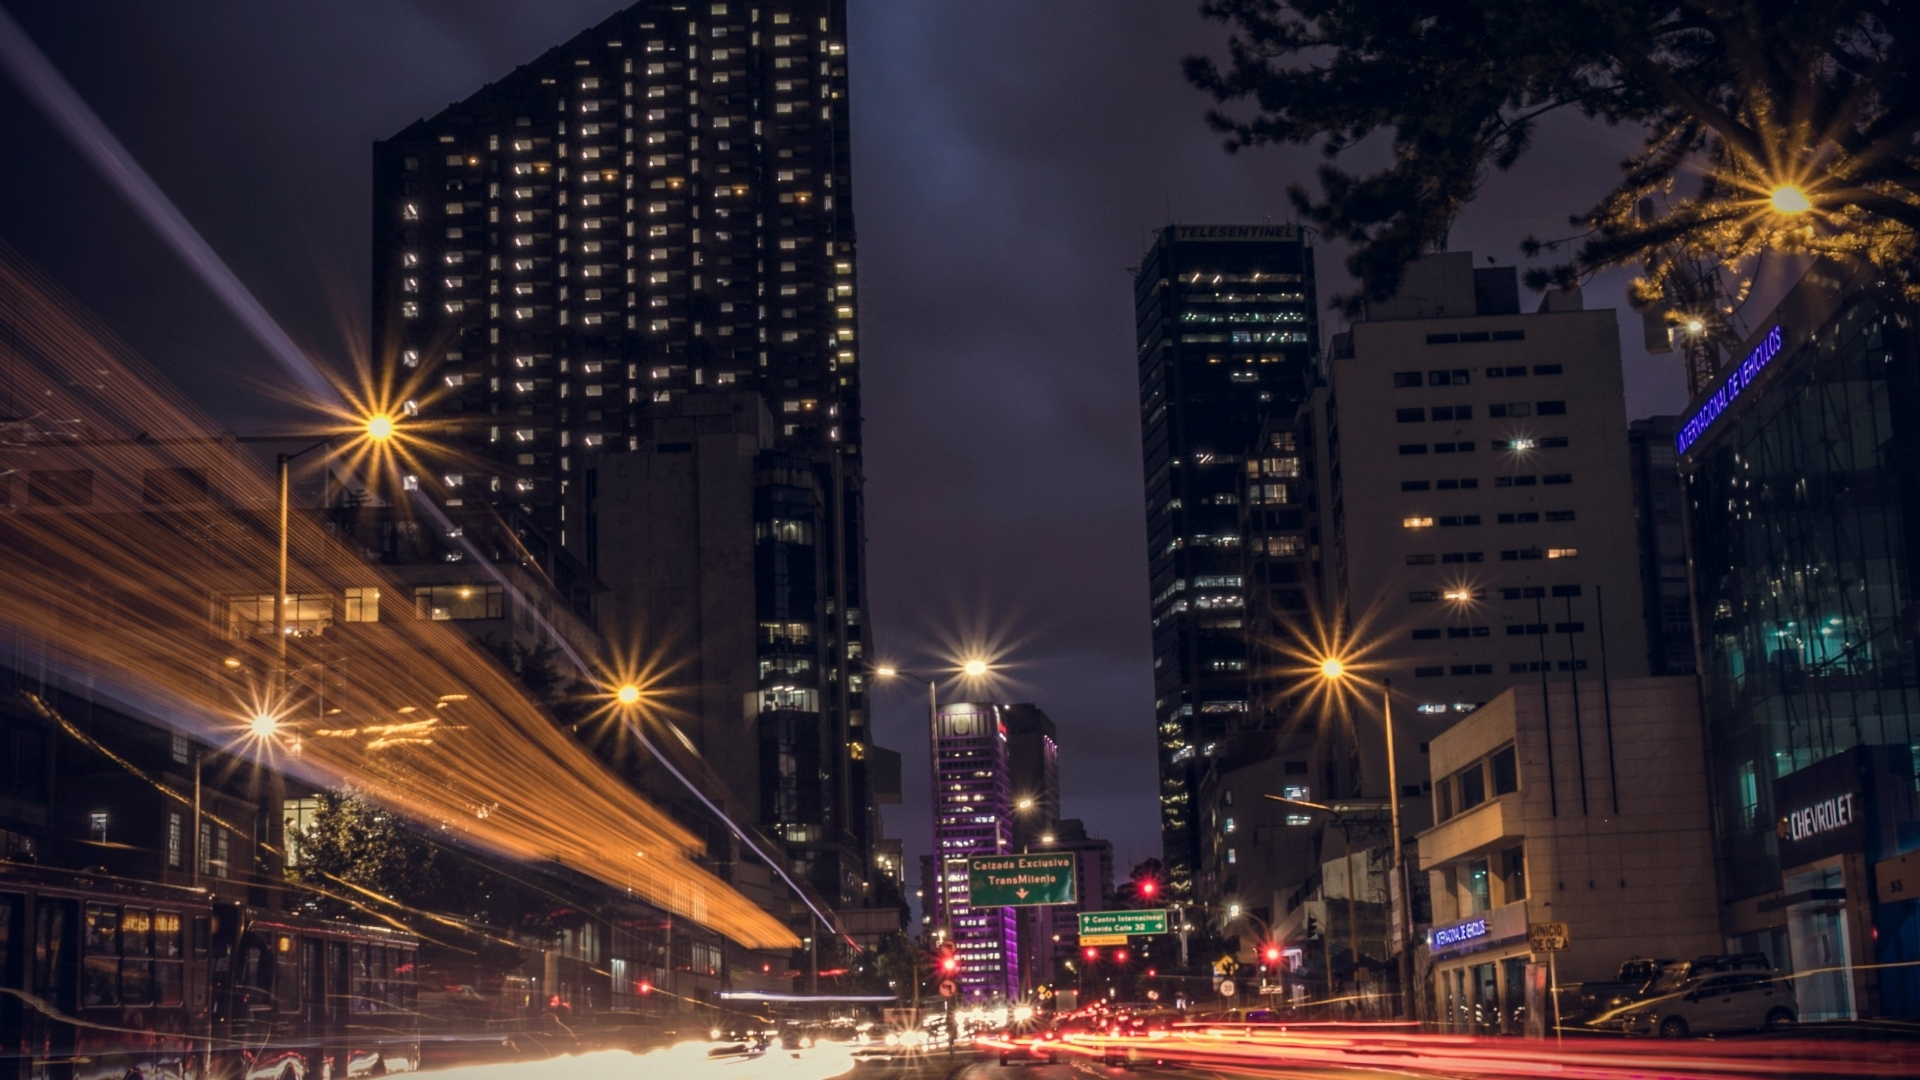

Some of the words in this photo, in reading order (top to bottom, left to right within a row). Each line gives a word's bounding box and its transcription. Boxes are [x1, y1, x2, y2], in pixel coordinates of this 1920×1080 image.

[1180, 226, 1293, 238] TELESENTINEL
[1677, 386, 1729, 455] INTERNACIONAL
[1728, 372, 1740, 401] DE
[1739, 325, 1782, 388] VEHICULOS
[1790, 793, 1853, 841] CHEVROLET
[973, 861, 1015, 871] Calzada
[1018, 858, 1070, 869] Exclusiva
[988, 874, 1057, 886] TransMilenio
[1118, 914, 1163, 922] Internacional
[1084, 925, 1112, 933] Avenida
[1114, 924, 1132, 932] Calle
[1135, 923, 1146, 931] 32
[1536, 924, 1563, 938] INICIO
[1533, 938, 1544, 951] DE
